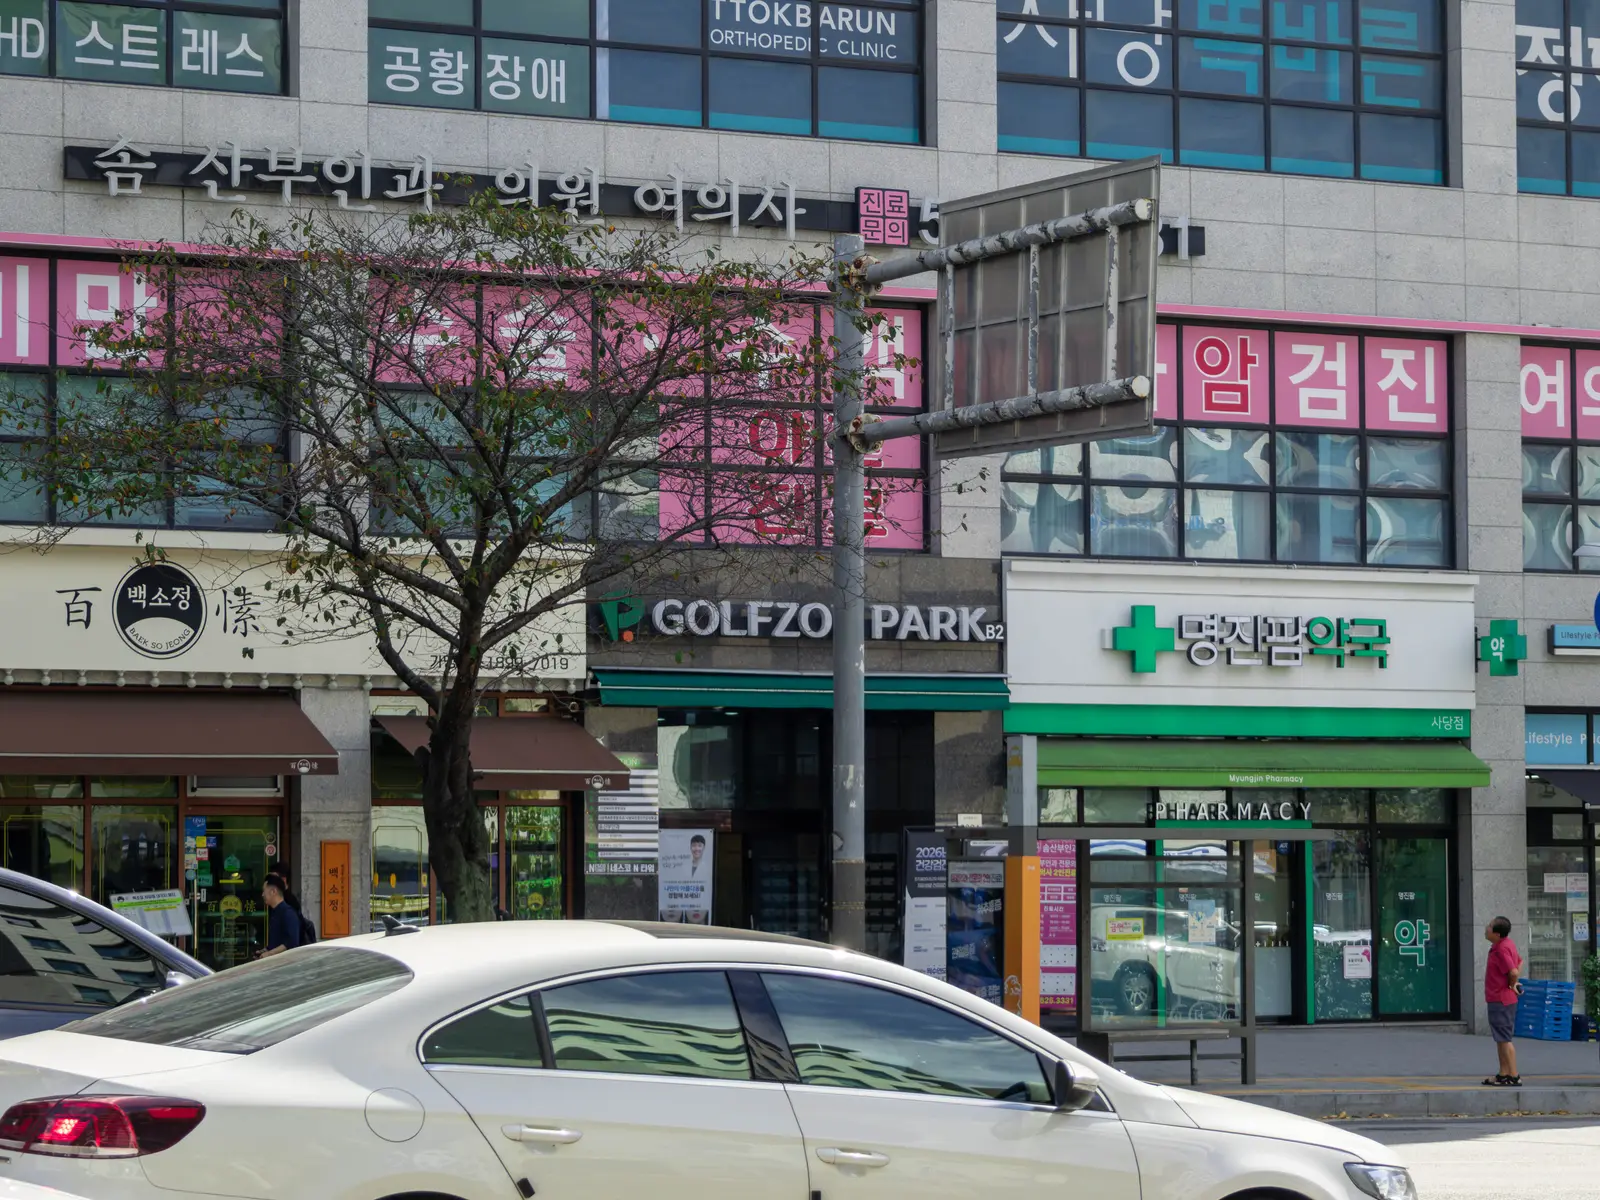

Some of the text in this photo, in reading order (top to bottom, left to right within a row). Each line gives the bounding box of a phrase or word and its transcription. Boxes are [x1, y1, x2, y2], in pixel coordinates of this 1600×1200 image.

[75, 20, 264, 78] 스트레스
[837, 39, 897, 59] CLINIC
[95, 133, 157, 197] 솜
[190, 139, 444, 215] 산부인과
[633, 173, 807, 241] 여의사
[863, 192, 906, 214] 진료
[862, 219, 905, 243] 문의
[1155, 335, 1437, 424] 암검진
[56, 586, 102, 630] 百
[127, 584, 191, 610] 백소정
[651, 598, 1004, 642] GOLFZO PARK B2
[128, 626, 191, 650] BAEK SO JEONG
[1561, 631, 1592, 641] Lifestyle
[1490, 636, 1505, 662] 약
[487, 655, 569, 670] 18997019
[1432, 715, 1464, 731] 사당점
[1524, 731, 1573, 748] ifestyle
[1229, 774, 1304, 783] Myungjin Pharmacy
[1155, 802, 1312, 821] PHARMACY
[328, 866, 340, 912] 백소정
[1394, 919, 1431, 967] 약
